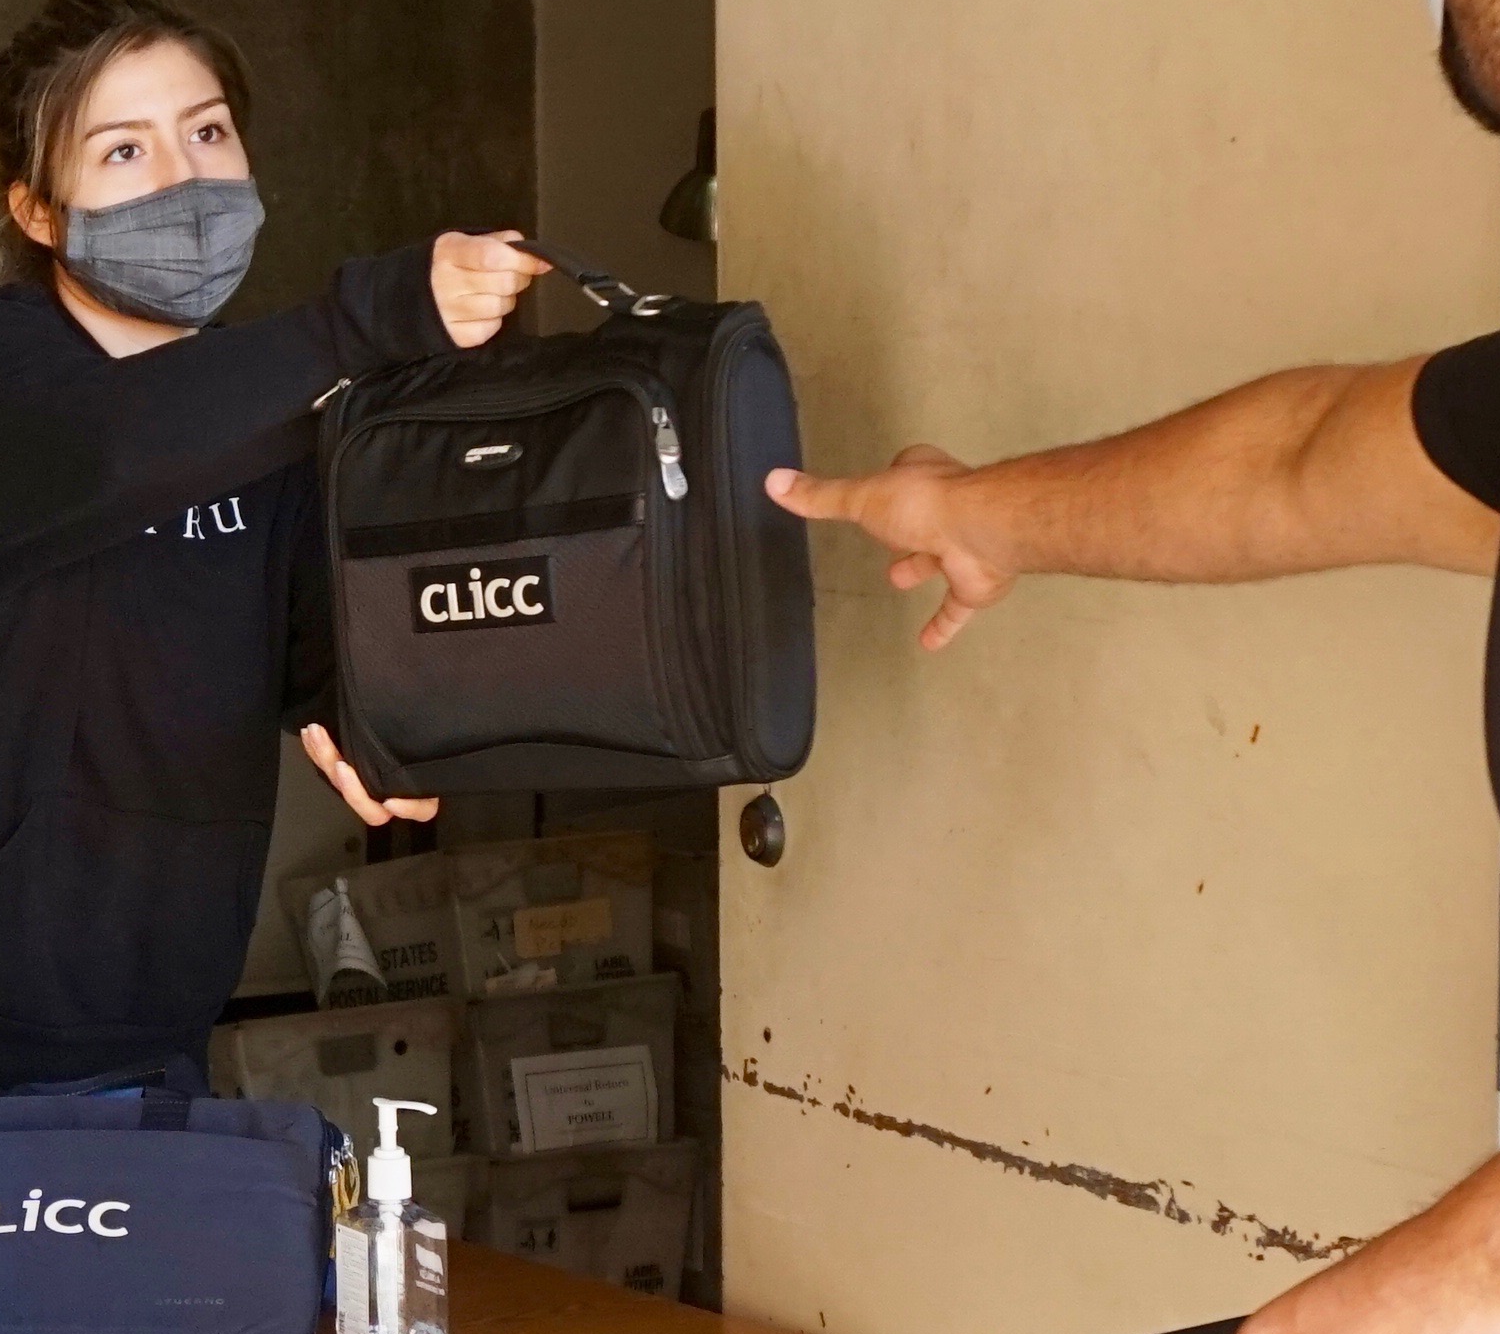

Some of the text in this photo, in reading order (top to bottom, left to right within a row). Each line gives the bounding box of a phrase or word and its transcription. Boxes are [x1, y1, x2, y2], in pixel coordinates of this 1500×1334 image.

[145, 497, 247, 541] RU
[380, 940, 438, 972] STATES
[567, 1110, 615, 1126] POWELL
